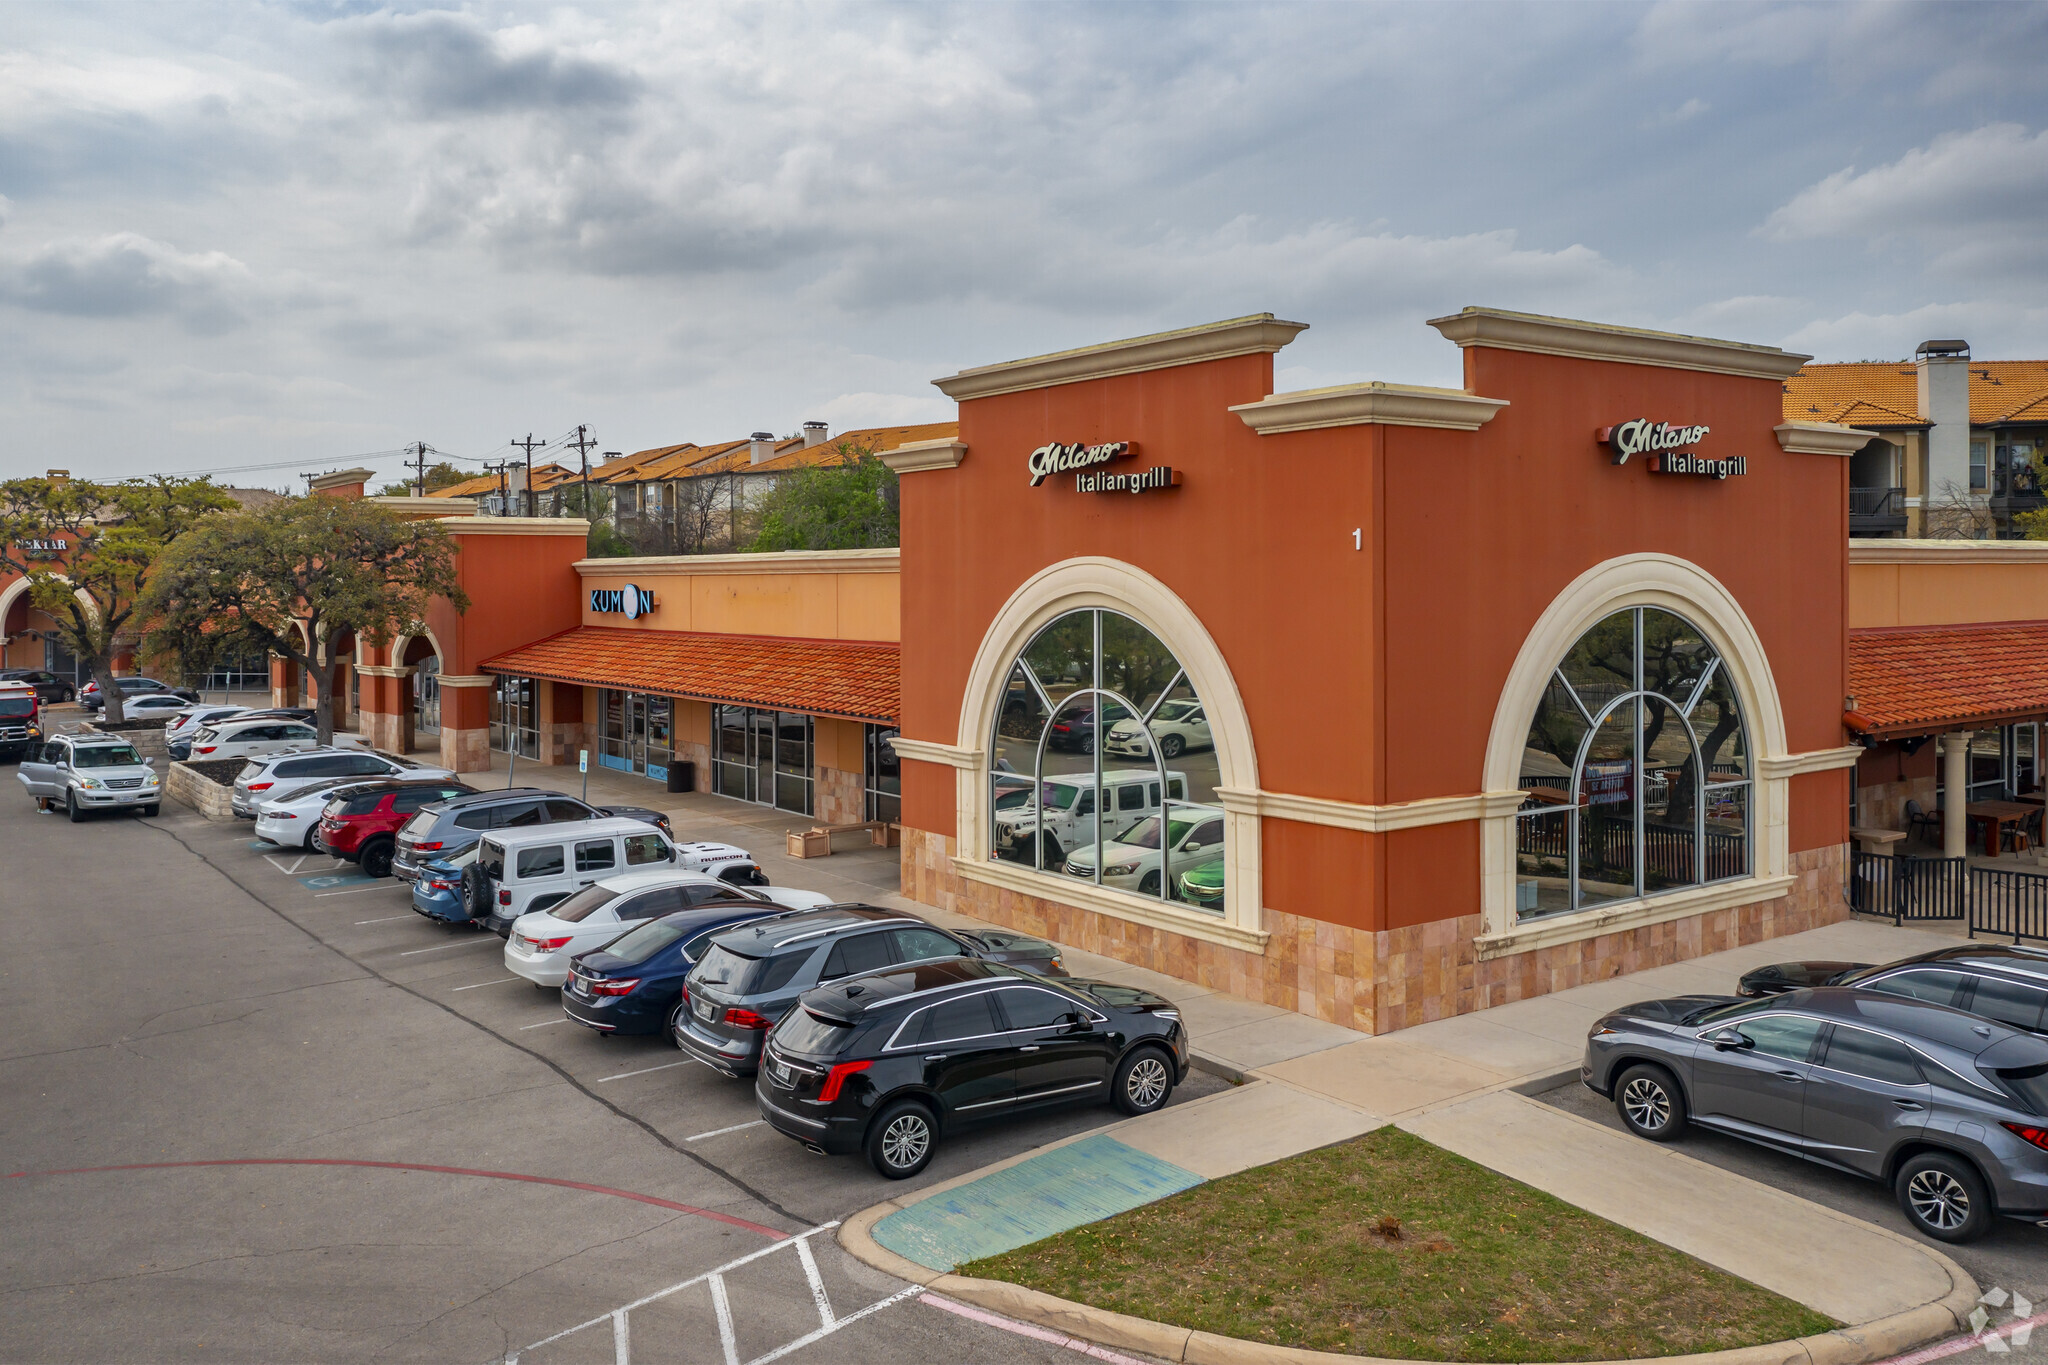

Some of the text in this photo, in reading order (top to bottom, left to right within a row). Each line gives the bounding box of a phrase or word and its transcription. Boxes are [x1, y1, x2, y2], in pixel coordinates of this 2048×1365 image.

[1616, 418, 1710, 465] Milano
[1028, 442, 1121, 487] Milano
[1668, 453, 1747, 480] Italian grill
[1076, 466, 1165, 494] Italian grill
[1352, 527, 1361, 551] 1
[590, 584, 651, 620] KUMON
[700, 854, 743, 863] RUBICON
